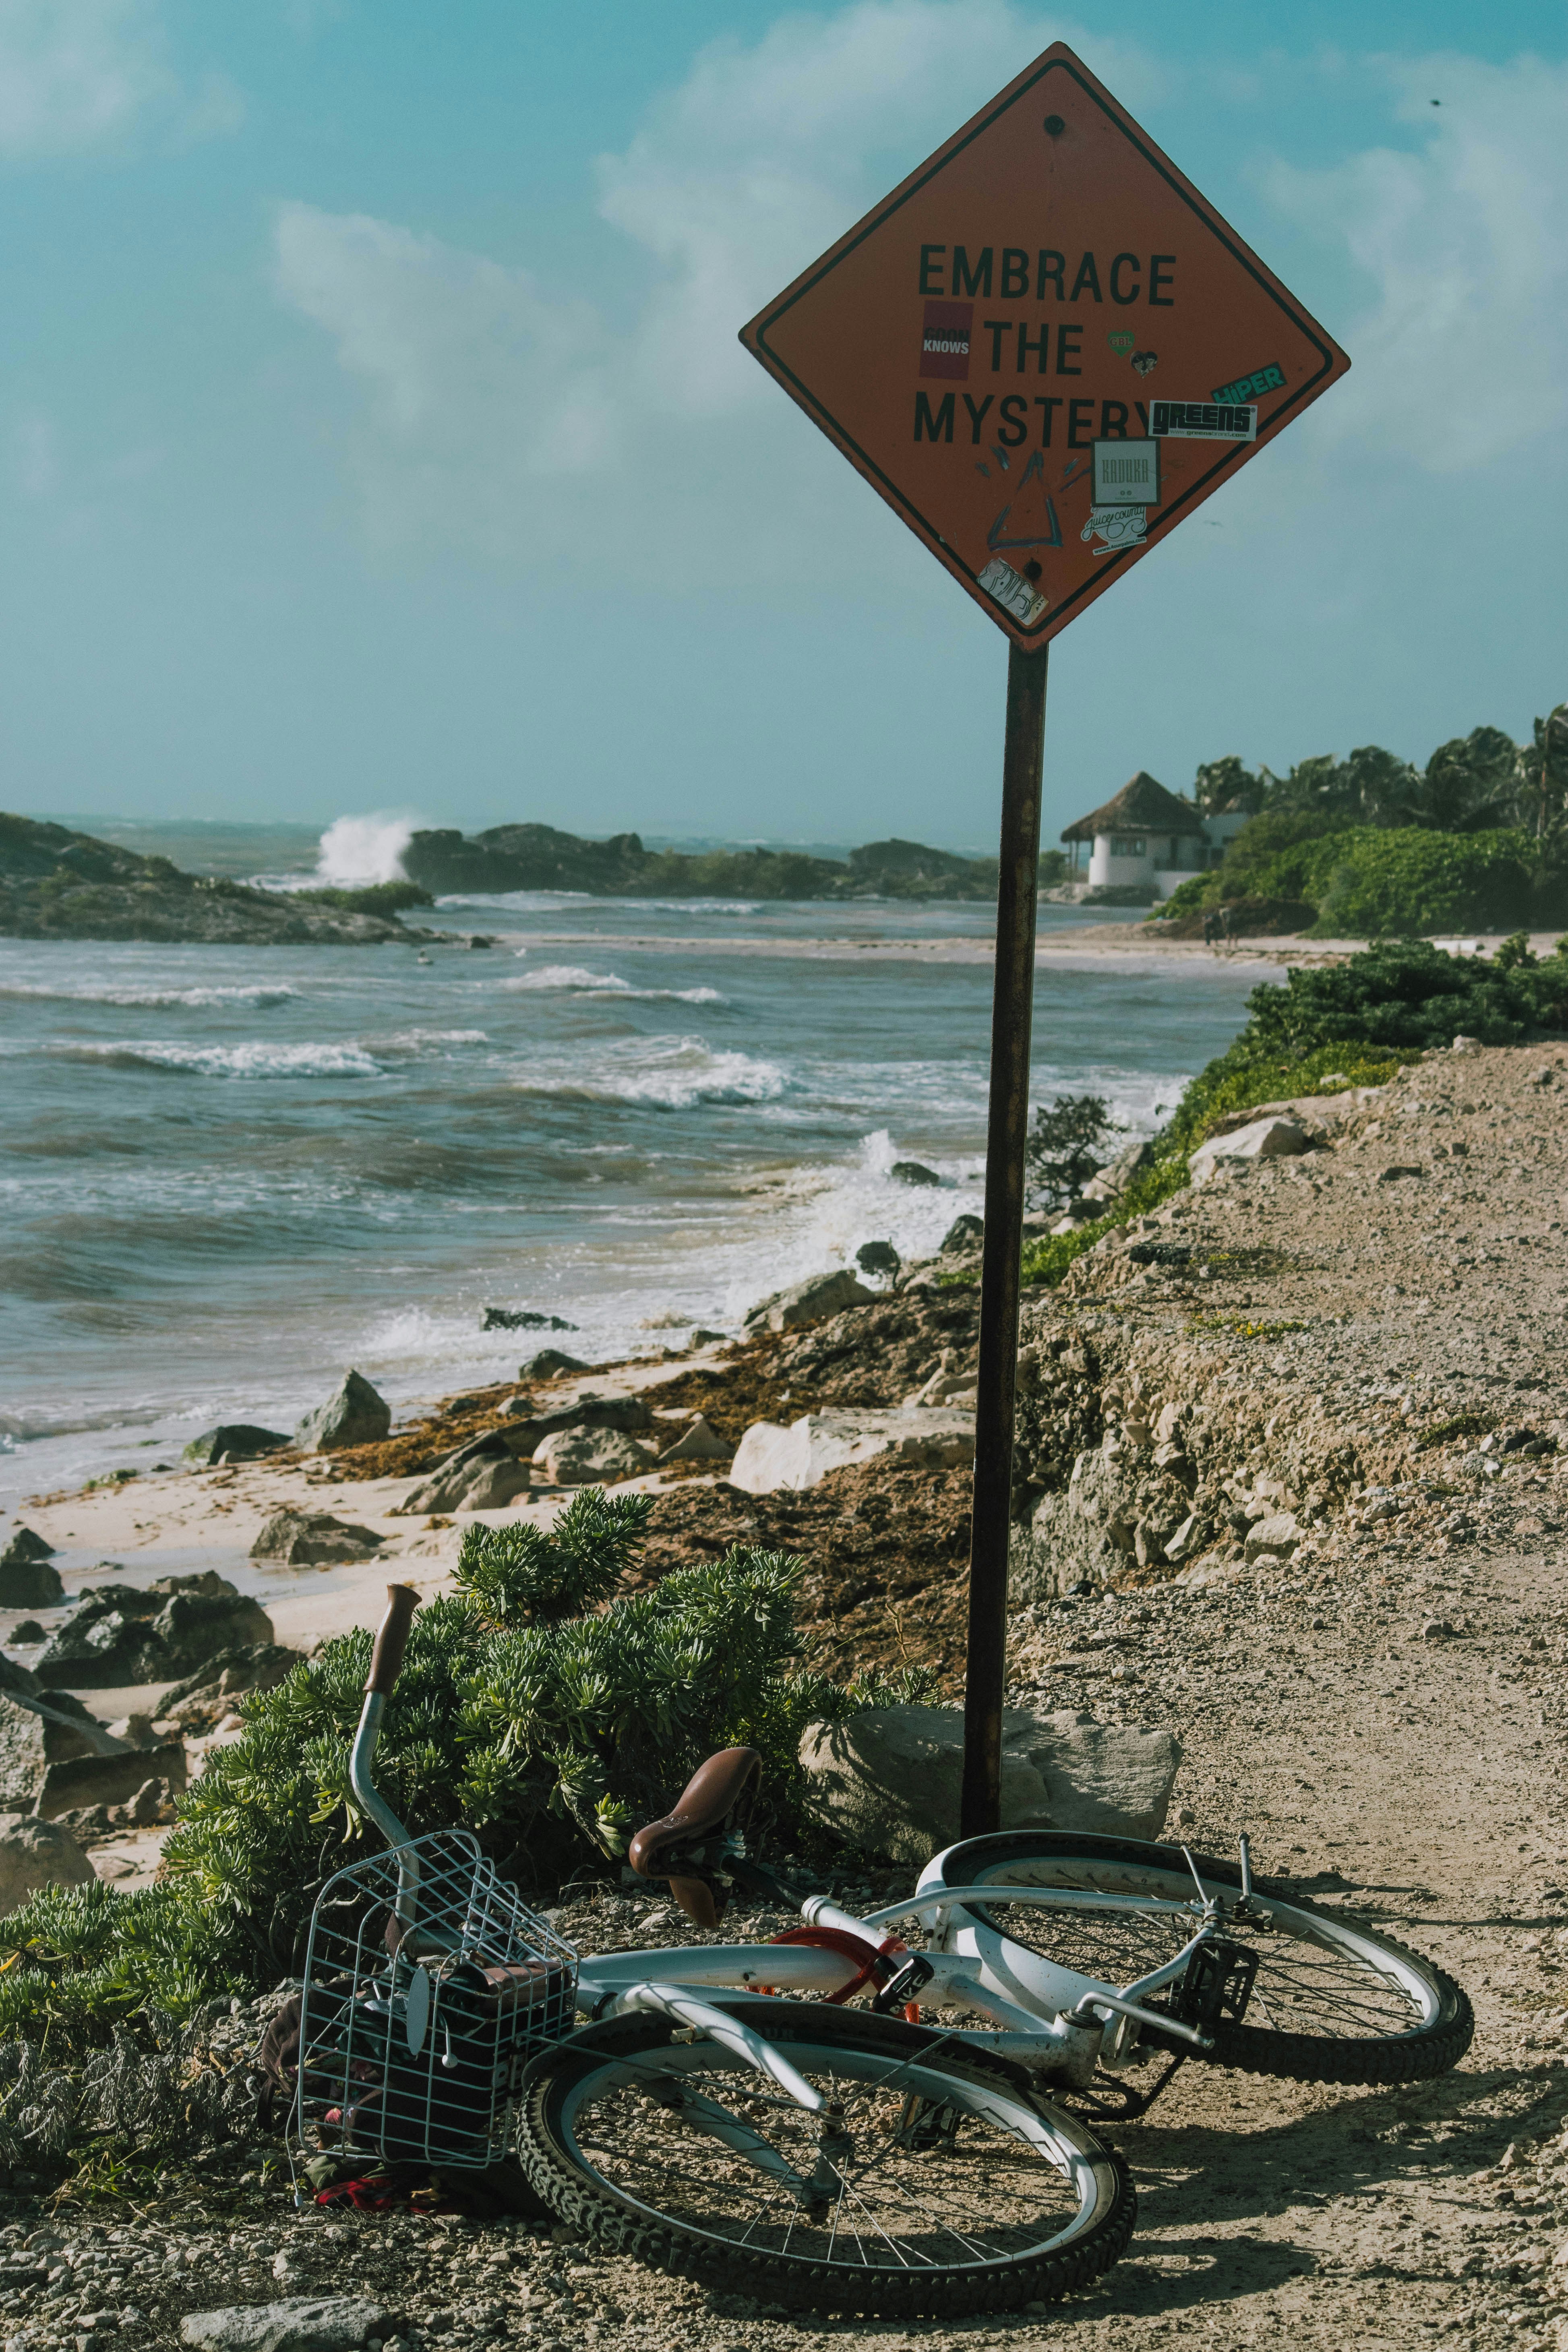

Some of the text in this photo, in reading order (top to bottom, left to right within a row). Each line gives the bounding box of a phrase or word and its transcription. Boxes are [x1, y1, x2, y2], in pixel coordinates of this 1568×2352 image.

[918, 244, 1177, 306] EMBRACE
[923, 339, 969, 354] KNOWS
[983, 321, 1083, 375] THE
[1110, 337, 1131, 346] GBL
[1094, 537, 1146, 554] www.4ourpalms.com
